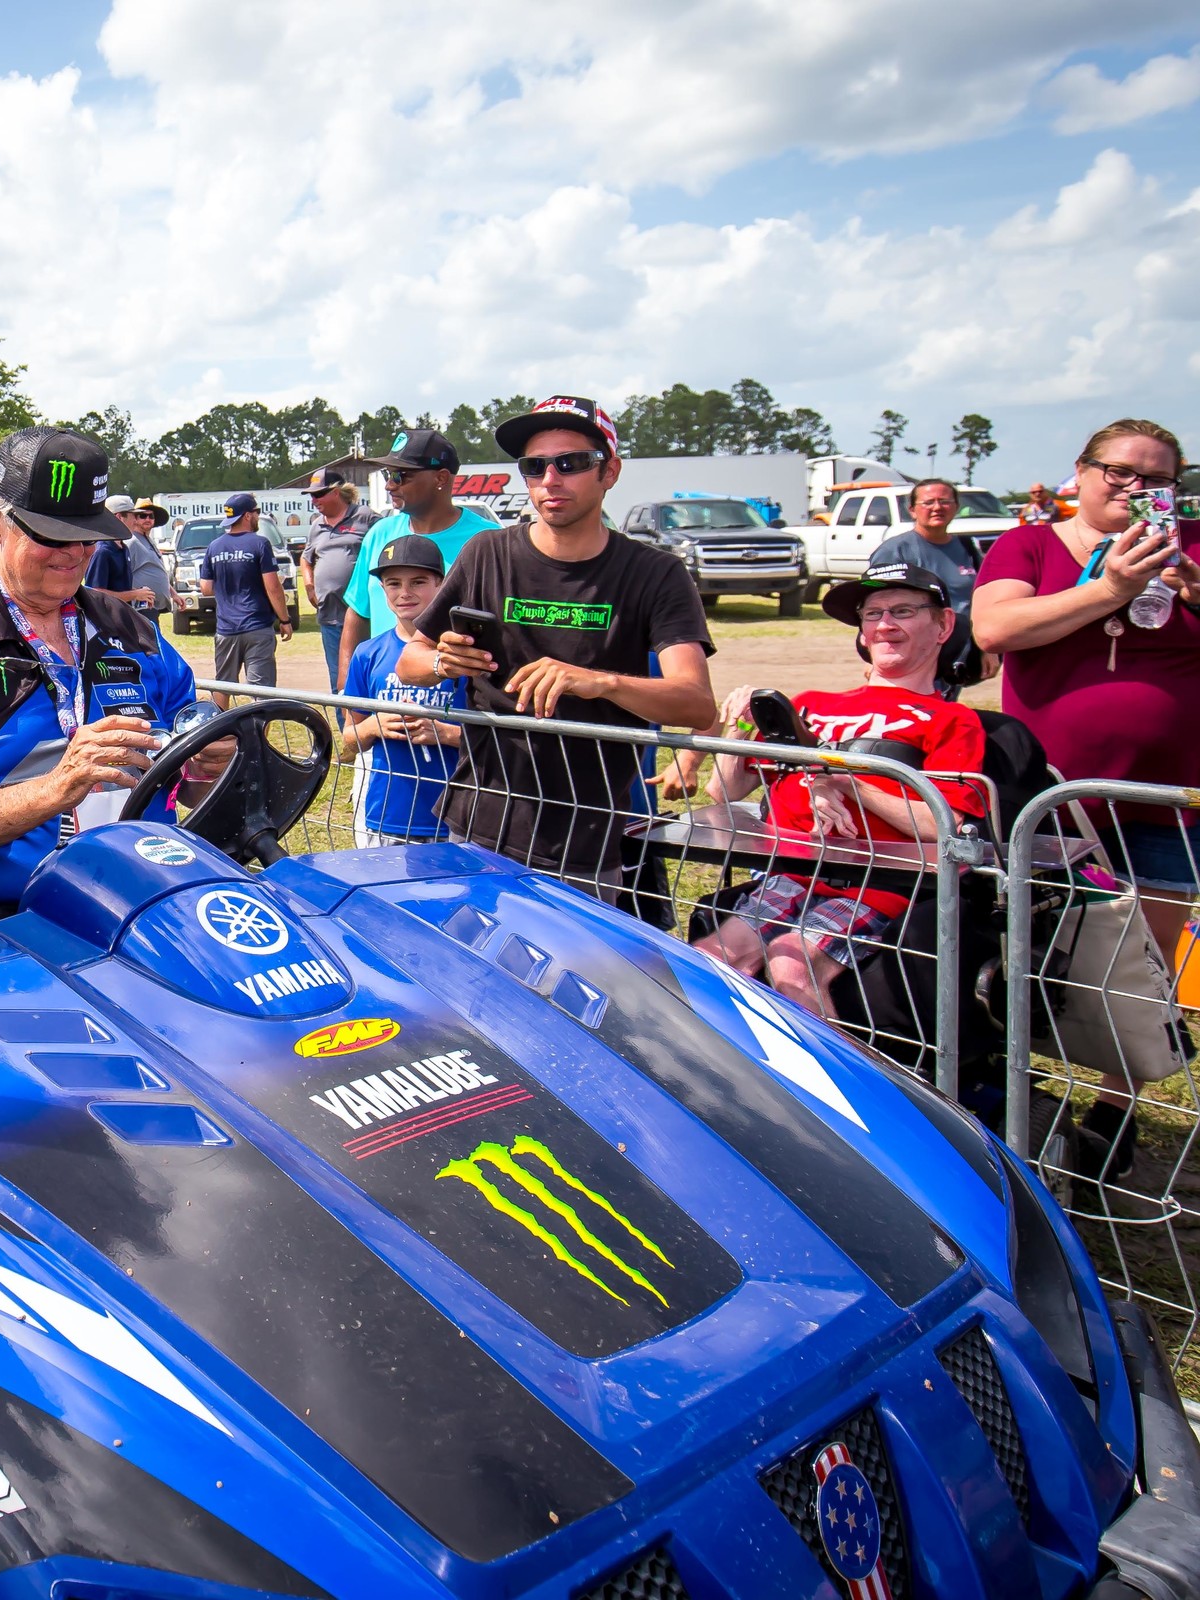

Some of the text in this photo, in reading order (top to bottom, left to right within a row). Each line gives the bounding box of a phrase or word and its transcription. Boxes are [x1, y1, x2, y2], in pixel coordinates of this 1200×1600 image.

[170, 505, 187, 517] Lite
[192, 504, 210, 516] Lite
[261, 502, 280, 513] Lite
[284, 500, 302, 513] Lite
[211, 550, 254, 563] nihilo
[571, 608, 606, 625] Racing
[234, 960, 345, 1006] YAMAHA
[301, 1018, 393, 1058] FMF
[309, 1050, 499, 1130] YAMALUBE
